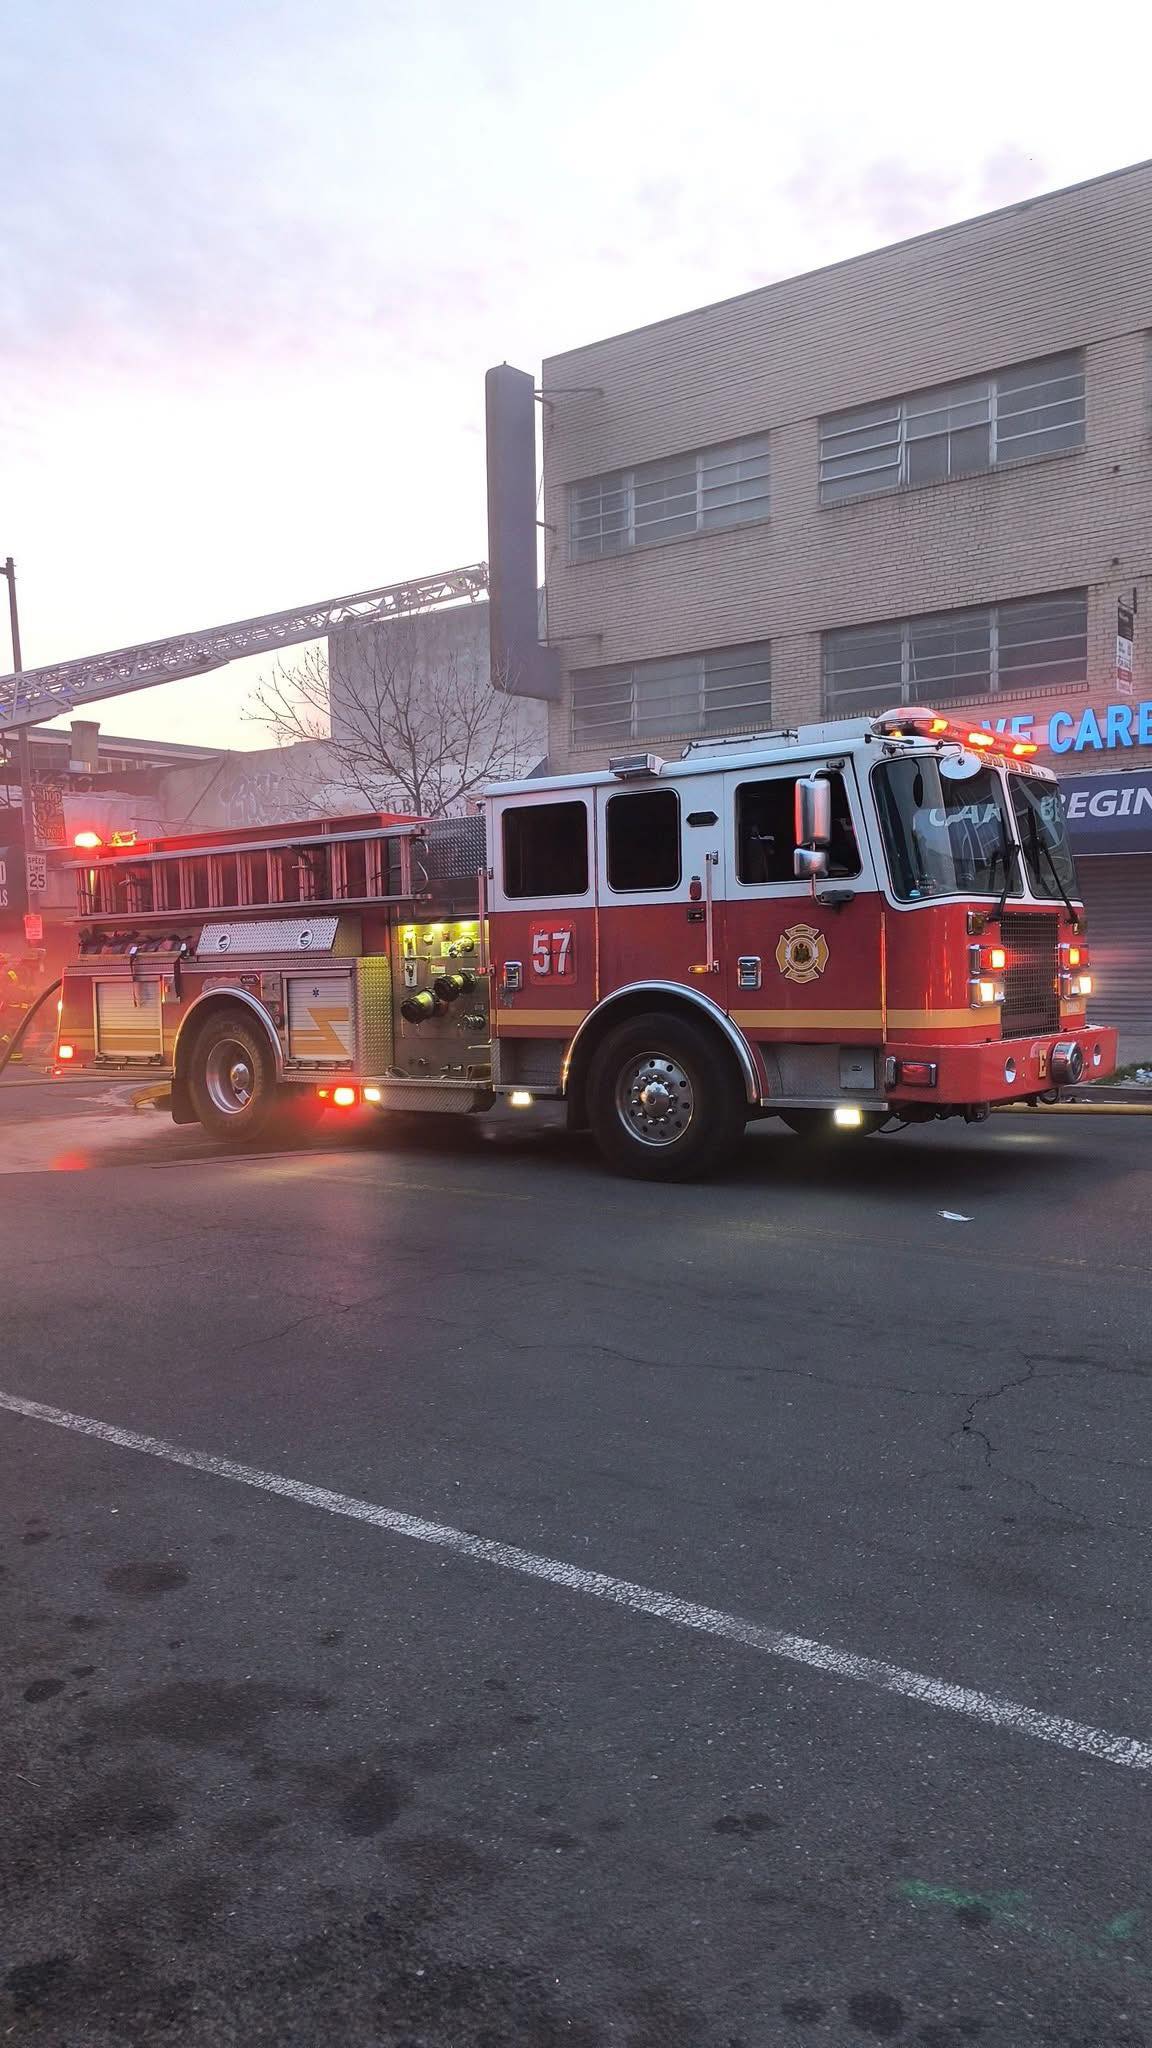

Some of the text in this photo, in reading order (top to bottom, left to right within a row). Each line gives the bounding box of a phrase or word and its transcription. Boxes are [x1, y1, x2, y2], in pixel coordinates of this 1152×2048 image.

[1048, 700, 1152, 754] CARE
[27, 856, 45, 865] SPEED
[29, 873, 45, 888] 25
[533, 932, 571, 974] 57
[1039, 1049, 1048, 1078] E
